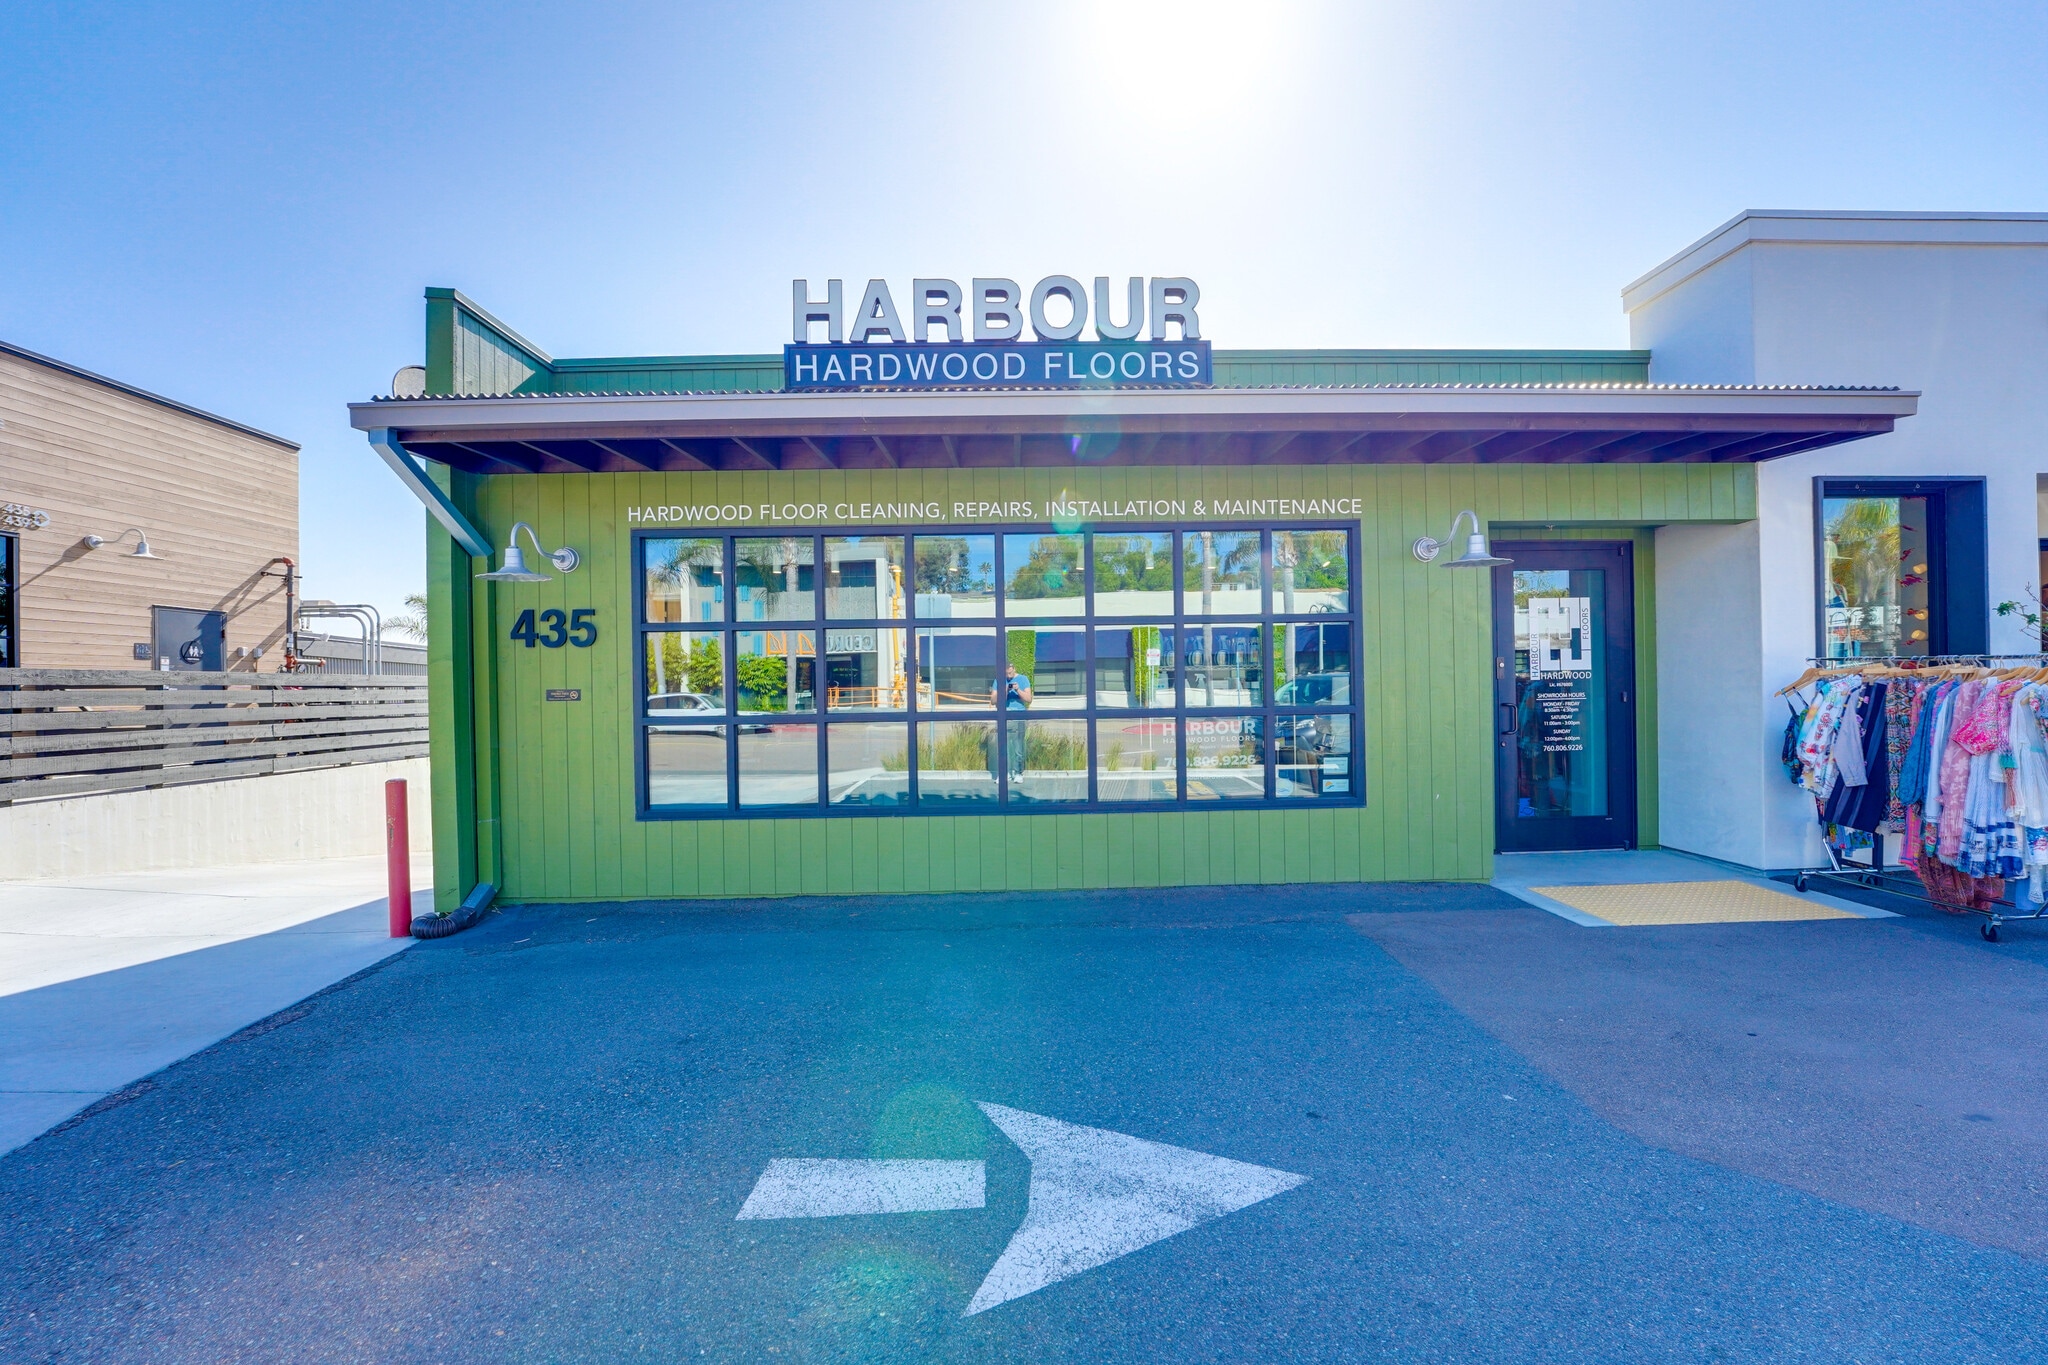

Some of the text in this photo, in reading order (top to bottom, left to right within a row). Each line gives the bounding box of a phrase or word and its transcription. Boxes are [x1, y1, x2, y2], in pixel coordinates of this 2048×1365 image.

[793, 275, 1201, 342] HARBOUR
[795, 351, 1200, 381] HARDWOOD FLOORS
[628, 498, 1363, 522] HARDWOOD FLOOR CLEANING, REPAIRS, INSTALLATION & MAINTENANCE
[510, 608, 597, 648] 435
[1582, 607, 1590, 640] FLOORS
[1531, 633, 1539, 678] HARBOUR
[1541, 671, 1592, 680] HARDWOOD
[1163, 719, 1256, 737] HRBOUR
[1220, 734, 1256, 743] FLOORS
[1543, 744, 1583, 752] 760.806.9226
